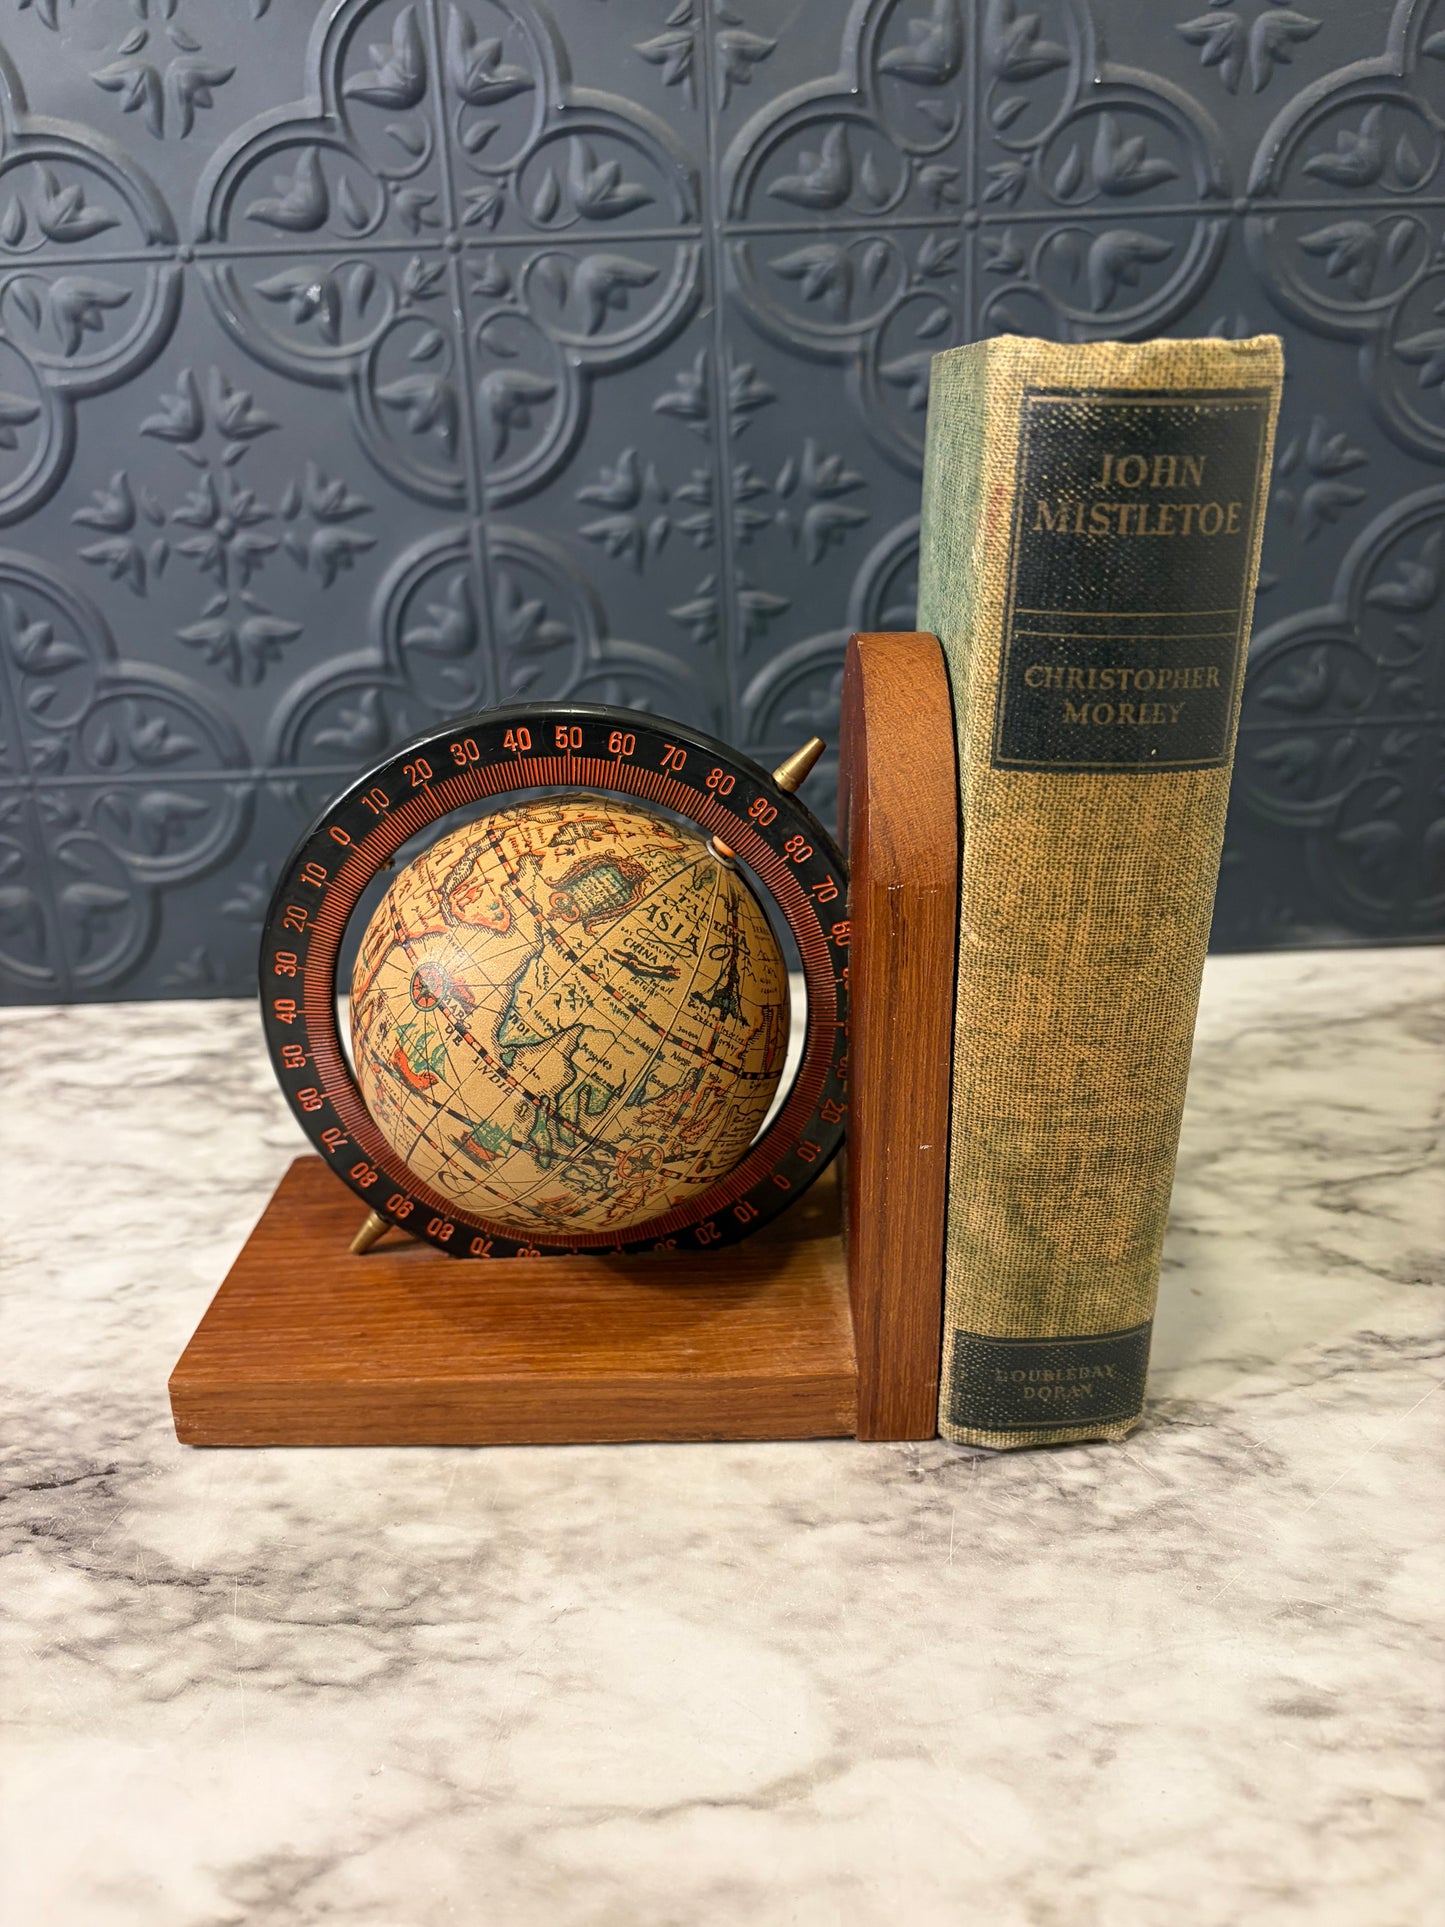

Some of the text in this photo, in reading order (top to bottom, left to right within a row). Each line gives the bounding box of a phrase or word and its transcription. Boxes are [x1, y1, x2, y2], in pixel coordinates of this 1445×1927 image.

[1099, 454, 1207, 488] JOHN
[1032, 502, 1241, 535] MISTLETOE
[1023, 665, 1220, 691] CHRISTOPHER
[1061, 701, 1185, 726] MORLEY
[503, 727, 532, 752] 40
[555, 725, 583, 749] 50
[608, 731, 636, 756] 60
[450, 738, 480, 766] 30
[659, 743, 687, 771] 70
[403, 758, 432, 787] 20
[705, 767, 735, 797] 80
[361, 788, 390, 814] 10
[748, 797, 778, 827] 90
[329, 826, 351, 846] 0
[784, 834, 813, 864] 80
[300, 862, 327, 887] 10
[811, 874, 838, 904] 70
[283, 905, 308, 932] 20
[638, 903, 700, 957] ASIA
[274, 951, 297, 977] 30
[623, 937, 658, 965] CHINA
[273, 998, 297, 1024] 40
[281, 1044, 306, 1069] 50
[297, 1087, 323, 1112] 60
[820, 1099, 848, 1124] 20
[321, 1127, 348, 1154] 70
[797, 1141, 822, 1162] 10
[350, 1162, 379, 1188] 80
[773, 1175, 791, 1190] 0
[386, 1193, 414, 1219] 90
[734, 1201, 759, 1223] 10
[426, 1217, 455, 1242] 80
[694, 1222, 722, 1245] 20
[470, 1237, 494, 1258] 70
[1023, 1384, 1094, 1401] DORAN
